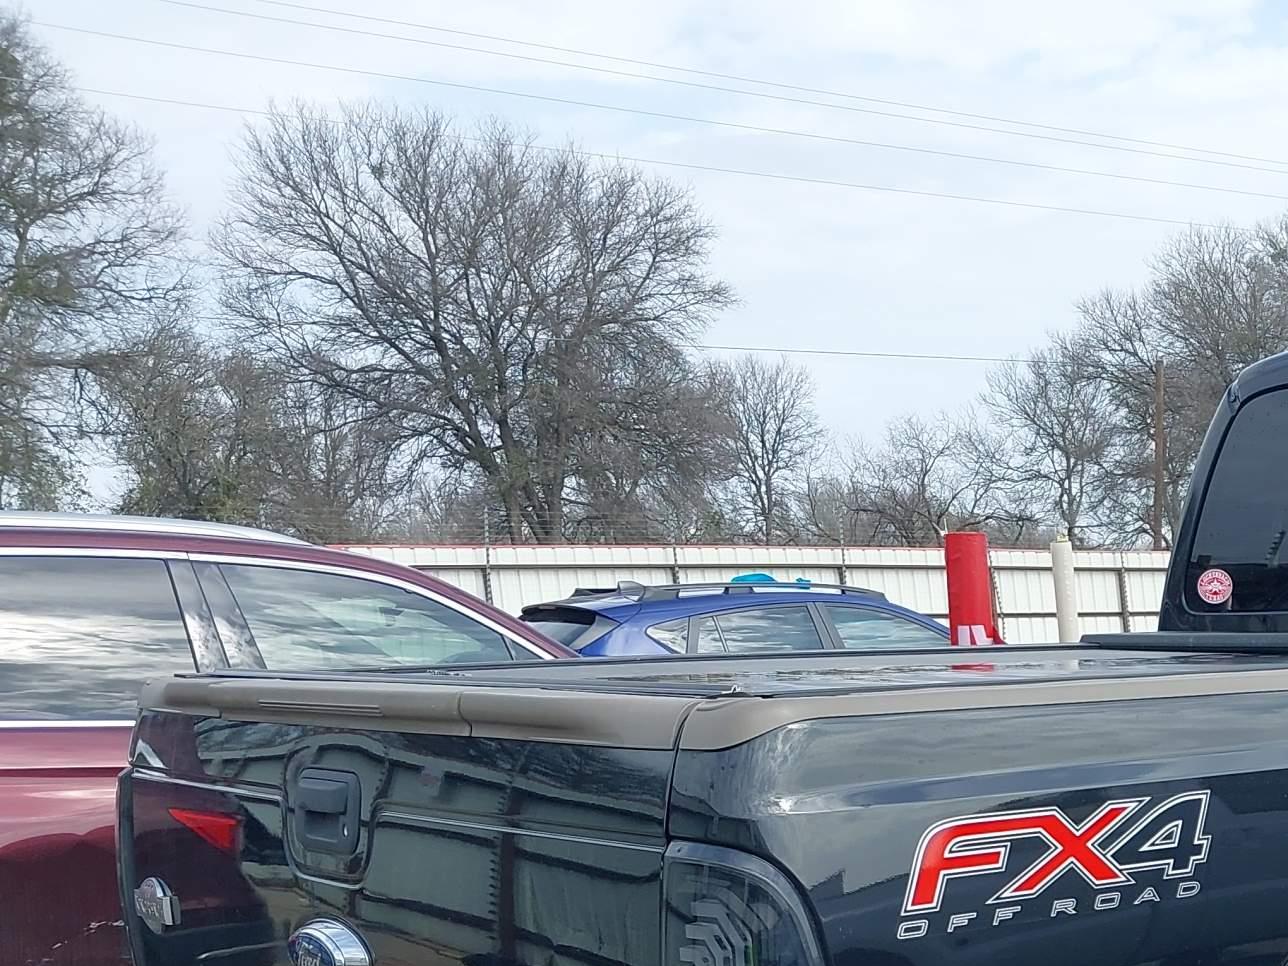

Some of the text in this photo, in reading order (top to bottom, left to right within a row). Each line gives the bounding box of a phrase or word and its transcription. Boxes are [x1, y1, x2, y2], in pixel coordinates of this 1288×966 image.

[900, 789, 1212, 917] FX4
[896, 881, 1202, 940] OFF ROAD
